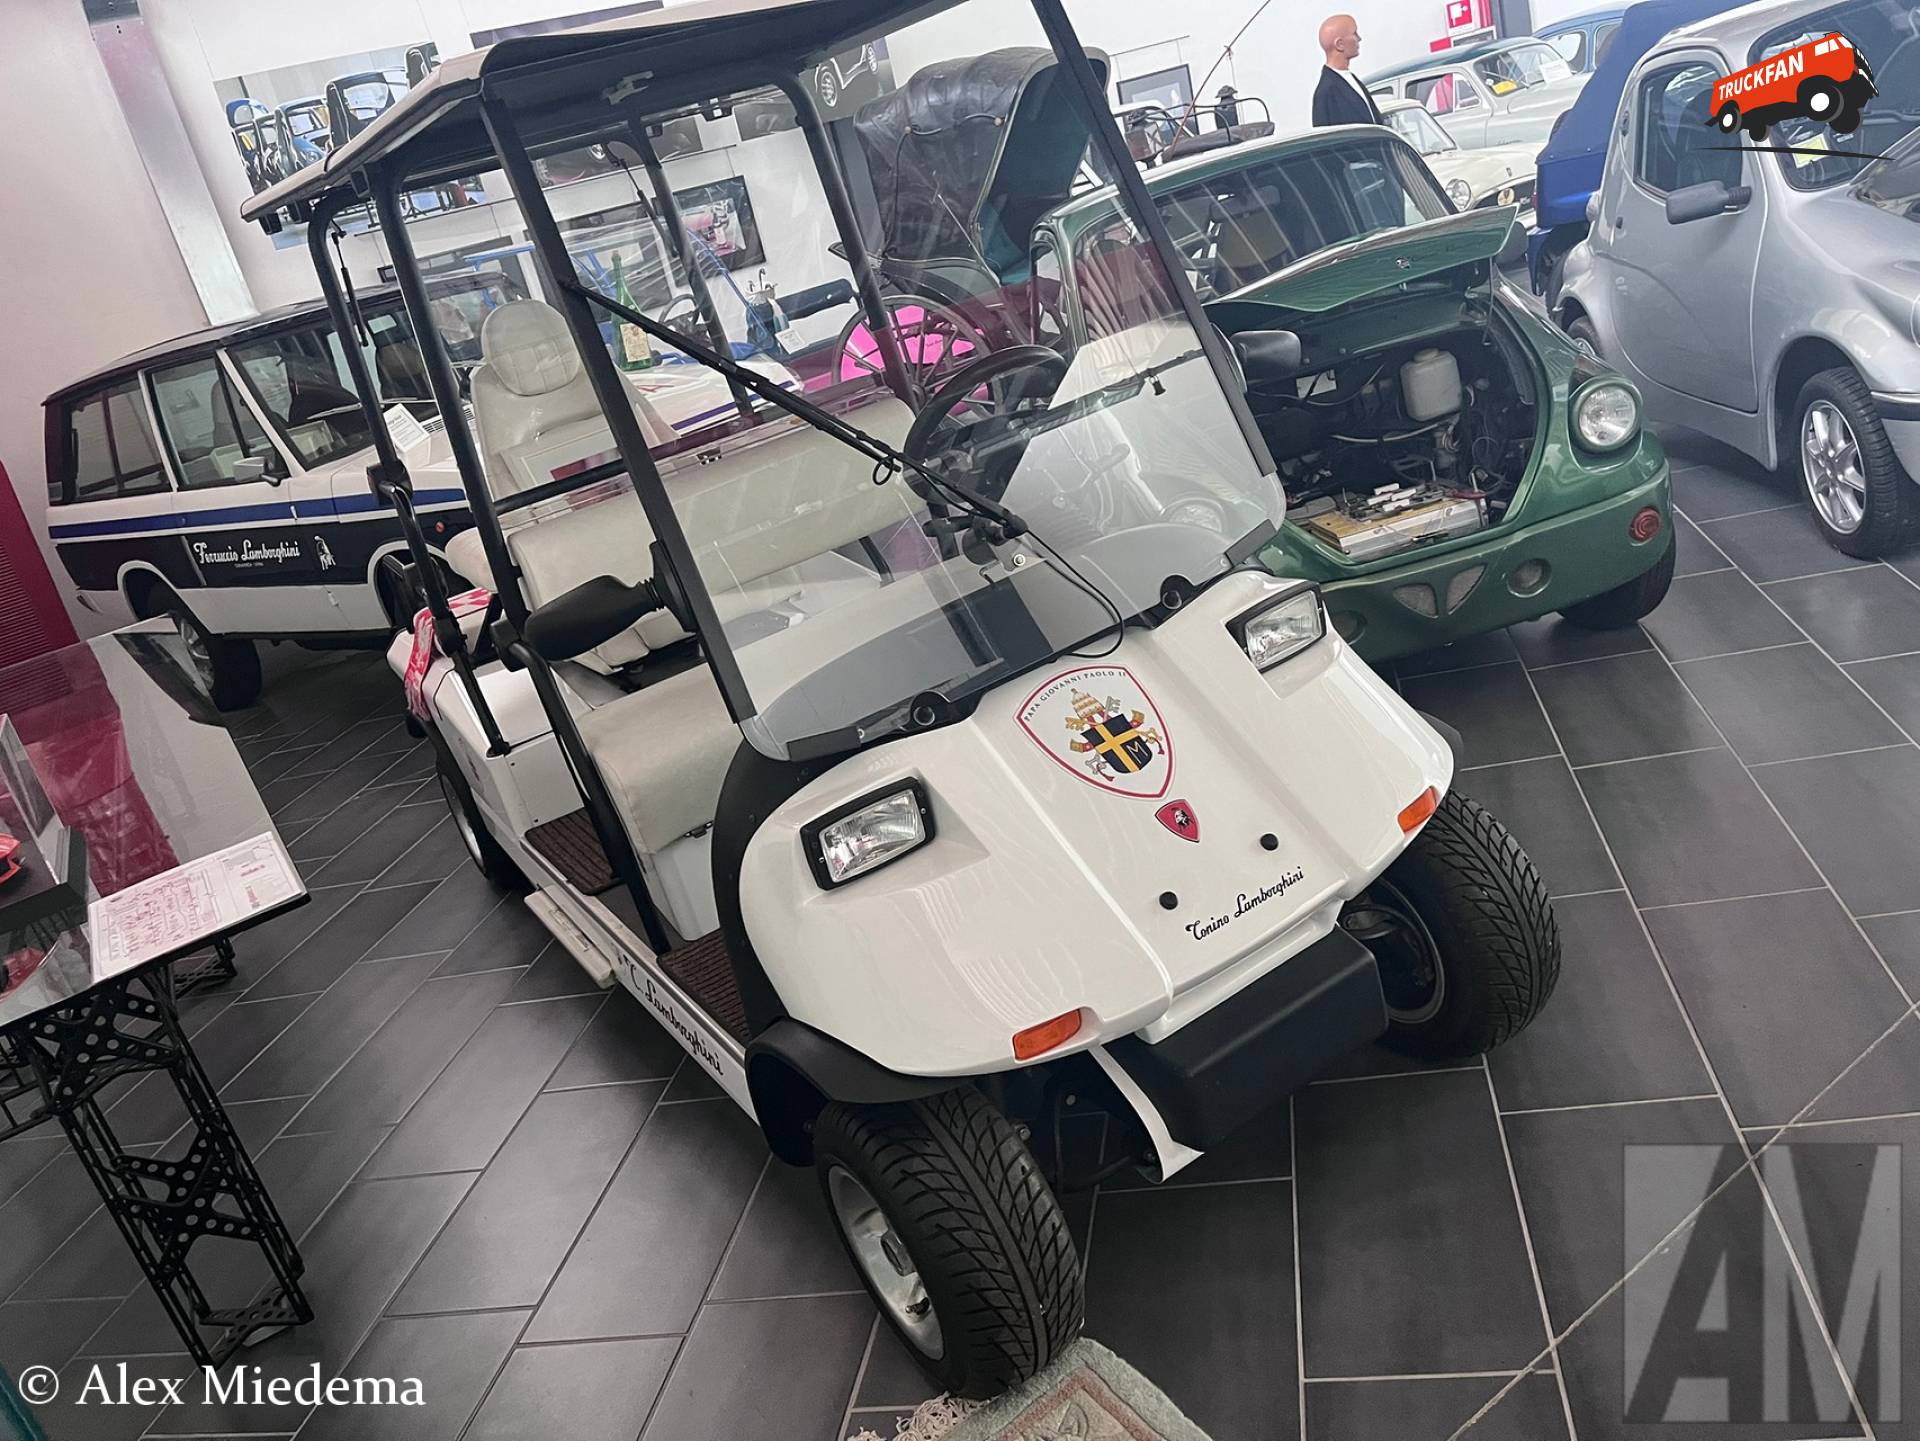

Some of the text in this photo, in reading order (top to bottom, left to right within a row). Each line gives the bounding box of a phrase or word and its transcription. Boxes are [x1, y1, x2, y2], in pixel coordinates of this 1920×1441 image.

[241, 539, 300, 563] Lamborghini
[1024, 703, 1041, 722] PAPA
[1040, 675, 1081, 701] GIOVANNI
[1084, 670, 1115, 679] PAOLO
[1185, 866, 1304, 941] Tonino Lamborghini
[645, 978, 724, 1076] Lamborghini
